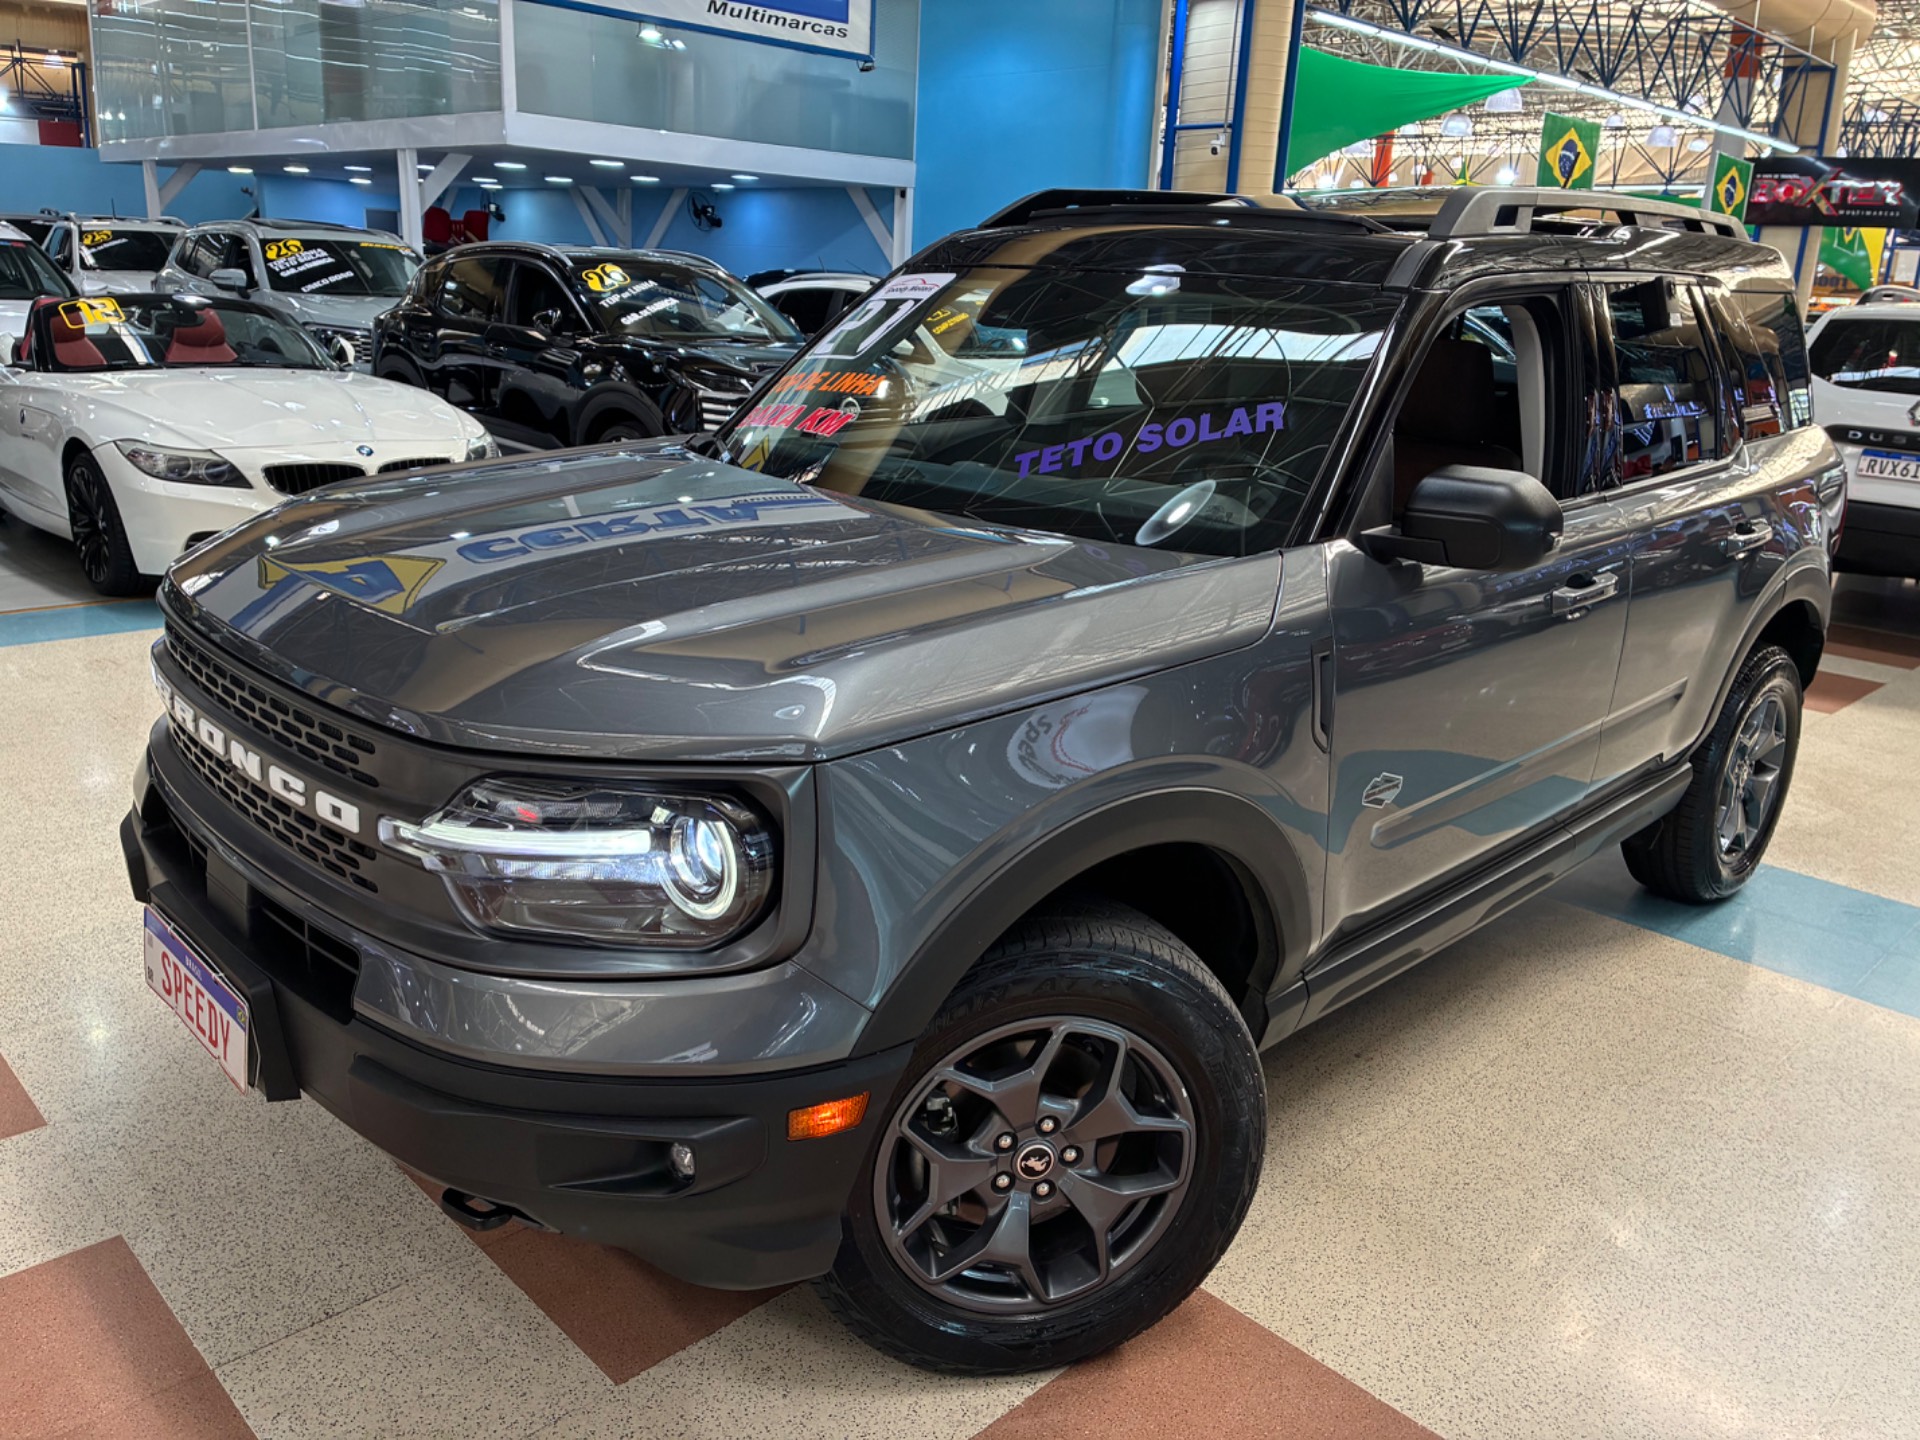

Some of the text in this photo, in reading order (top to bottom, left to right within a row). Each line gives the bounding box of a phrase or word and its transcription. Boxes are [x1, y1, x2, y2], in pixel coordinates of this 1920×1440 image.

[706, 0, 849, 39] Multimarcas
[265, 238, 305, 260] 26
[582, 263, 631, 291] 26
[819, 371, 887, 397] LINHA
[795, 407, 856, 438] KM
[1847, 429, 1920, 445] DUS
[1014, 402, 1285, 479] TETO SOLAR
[157, 673, 360, 834] BRONCO
[161, 950, 230, 1063] SPEEDY
